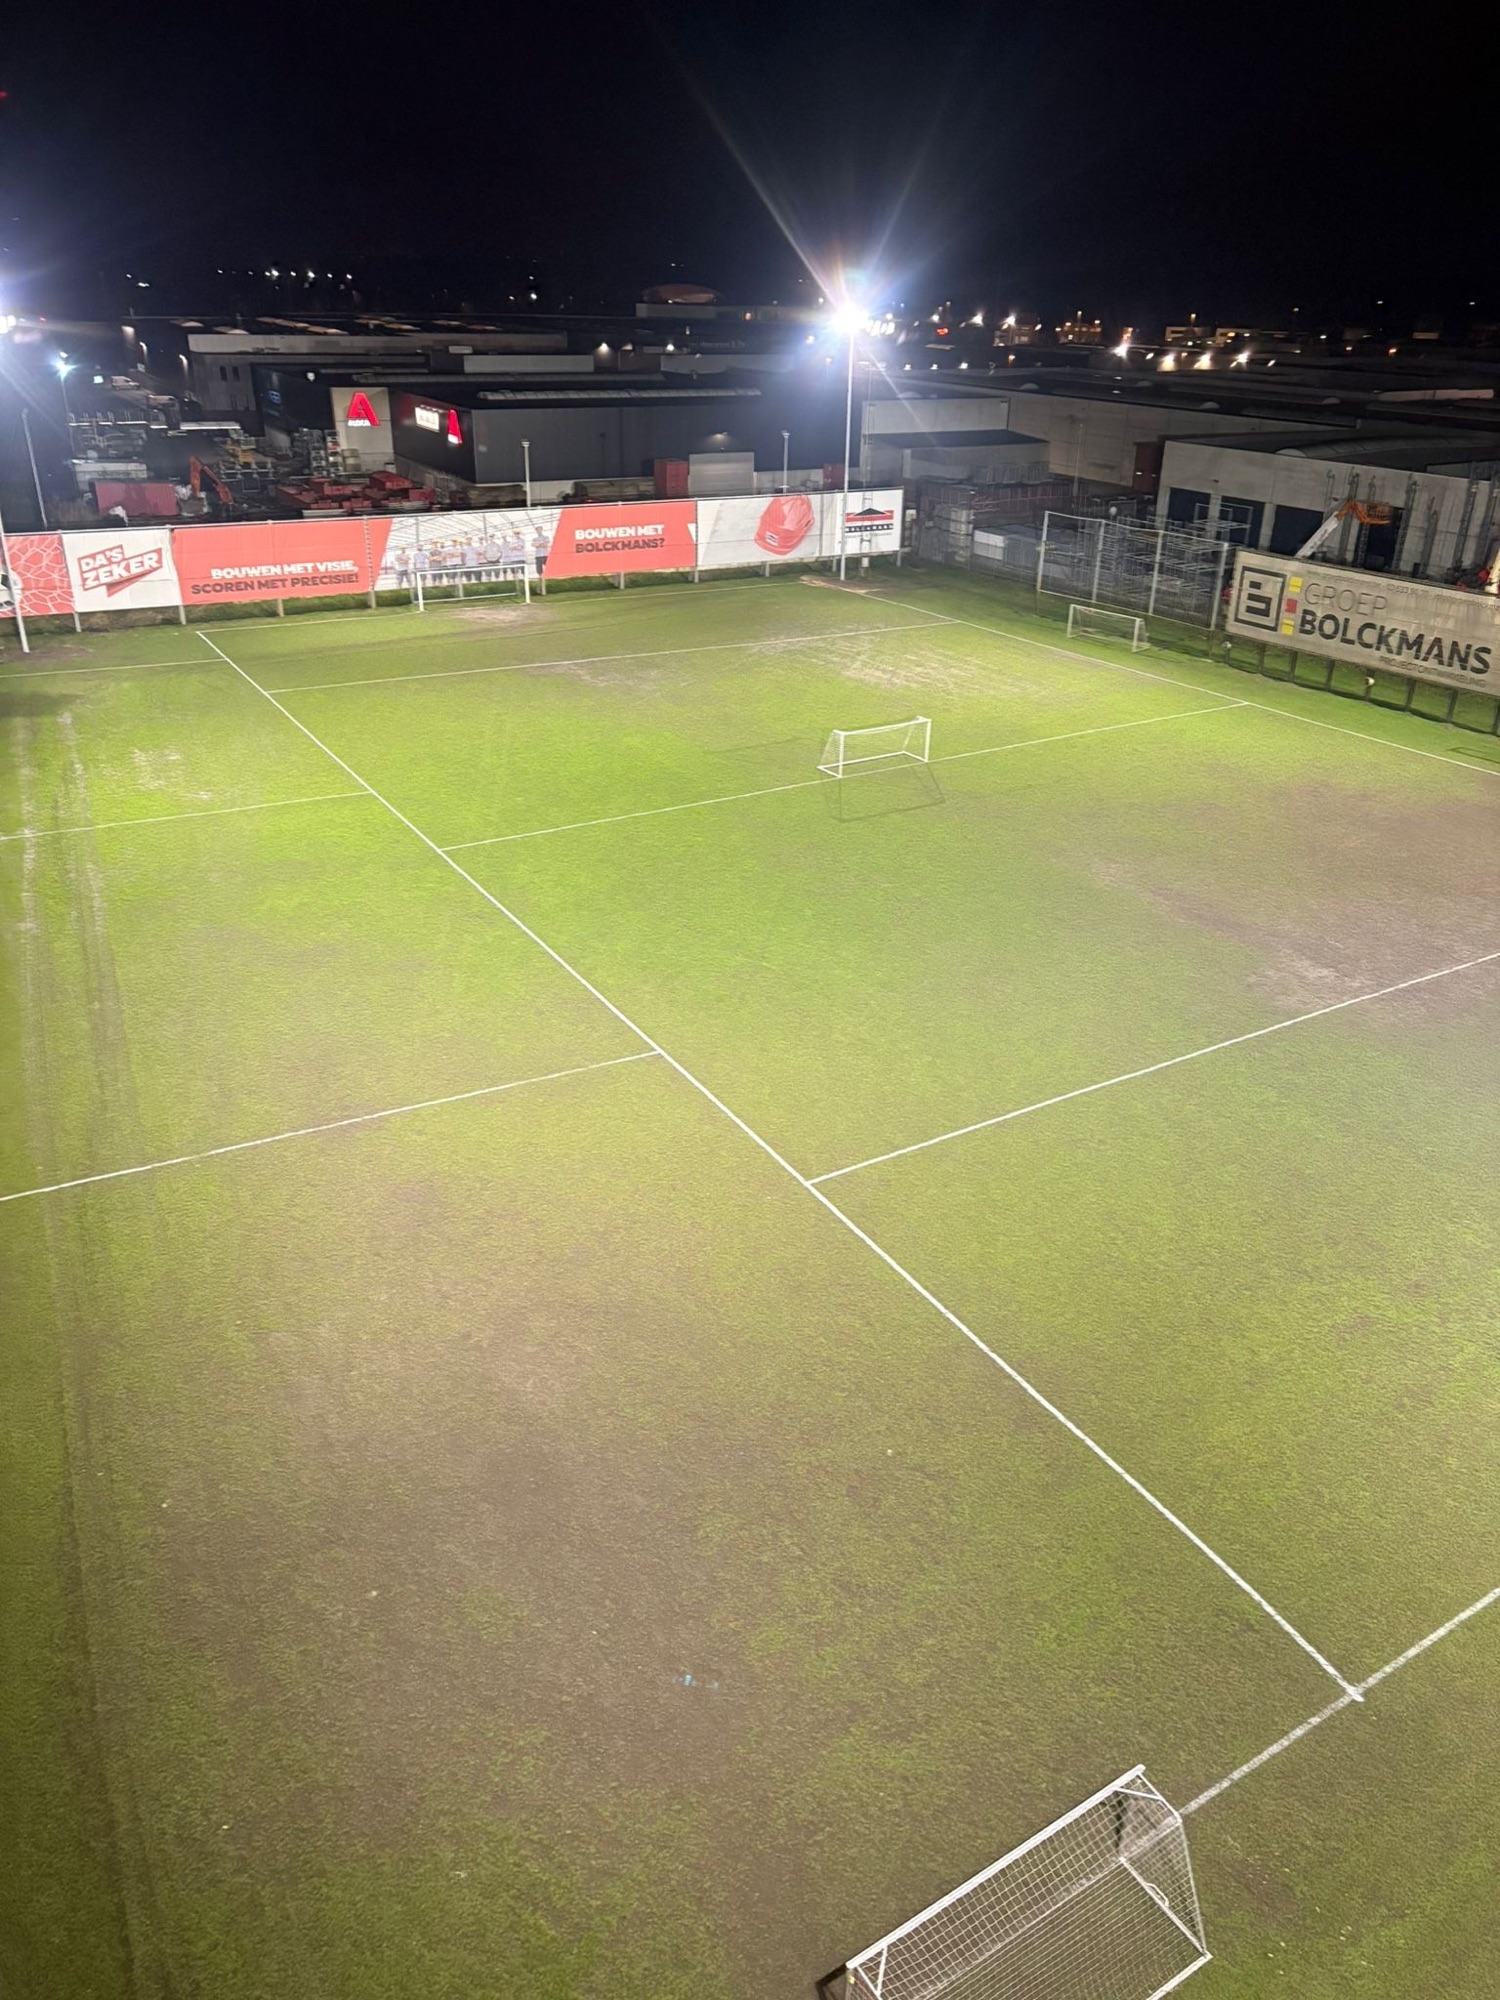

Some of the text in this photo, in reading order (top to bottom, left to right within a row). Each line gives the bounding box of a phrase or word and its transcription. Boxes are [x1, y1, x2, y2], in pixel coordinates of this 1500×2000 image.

[574, 524, 665, 540] BOUWEN MET
[575, 538, 665, 553] BOLCKMANS?
[80, 548, 123, 572] DA'S
[83, 552, 160, 588] ZEKER
[210, 560, 359, 579] BOUWEN MET VISIE,
[191, 573, 359, 595] SCOREN MET PRECISIE!
[1306, 584, 1387, 616] GROEP
[1300, 611, 1491, 674] BOLCKMANS
